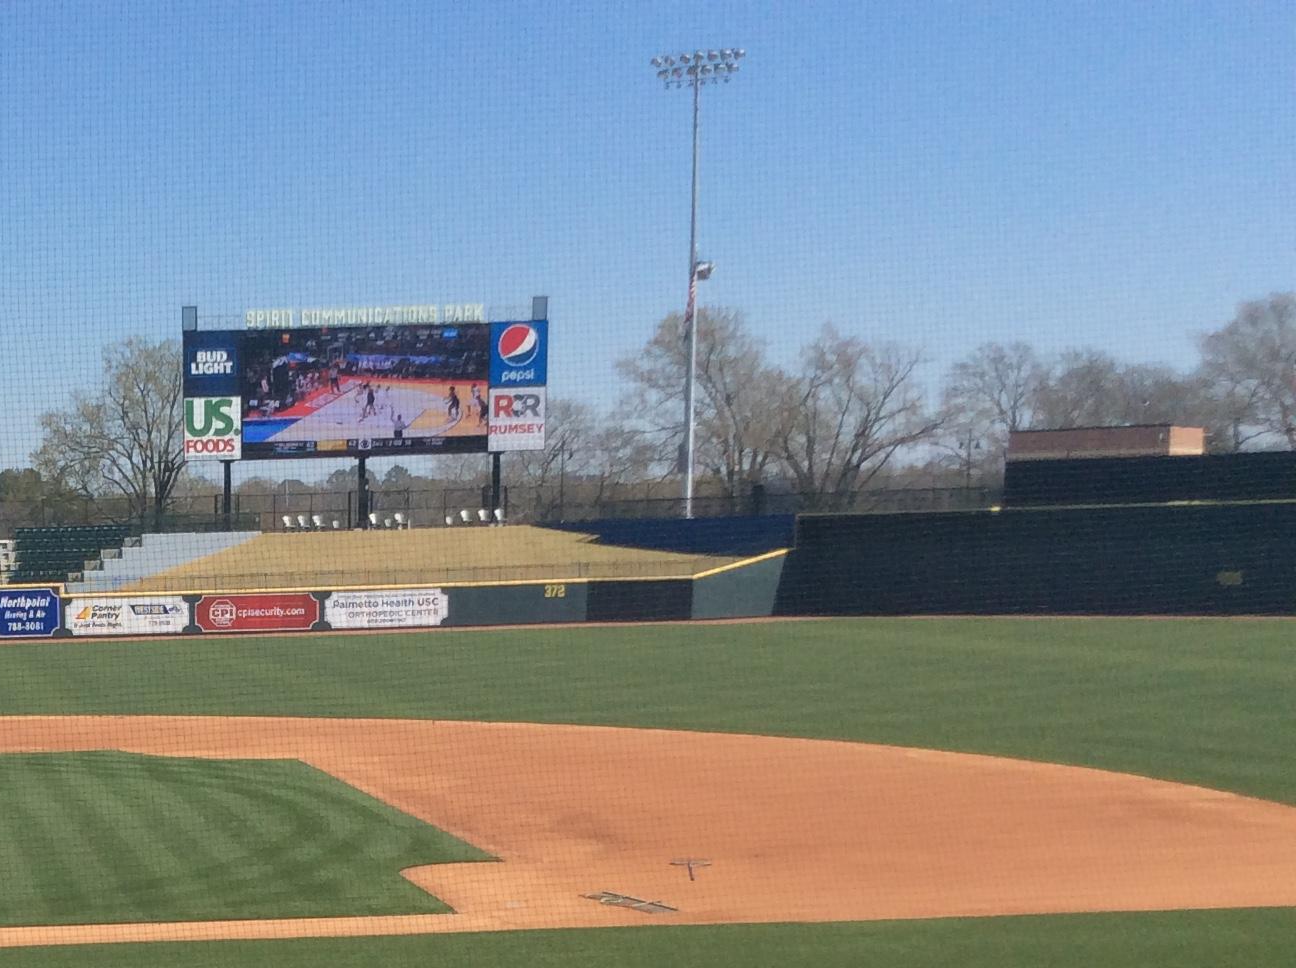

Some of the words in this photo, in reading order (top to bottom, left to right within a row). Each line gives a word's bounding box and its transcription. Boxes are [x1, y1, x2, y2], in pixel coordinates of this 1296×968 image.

[246, 308, 293, 328] SPIRIT
[301, 305, 437, 327] COMMUNICATIONS
[443, 303, 484, 323] PARK
[196, 350, 228, 363] BUD
[190, 361, 233, 375] LIGHT
[501, 368, 535, 383] pepsi
[489, 423, 544, 435] RUMSEY
[186, 438, 236, 454] FOODS
[0, 595, 51, 610] Northpoint
[92, 604, 122, 612] Corner
[333, 600, 378, 609] Palmetto
[381, 598, 415, 607] Health
[417, 597, 439, 607] USC
[91, 612, 120, 620] Pantry
[211, 607, 234, 618] CPI
[237, 606, 305, 619] cpisecurity.com
[348, 610, 404, 619] ORTHOPEDIC
[405, 609, 439, 617] CENTER
